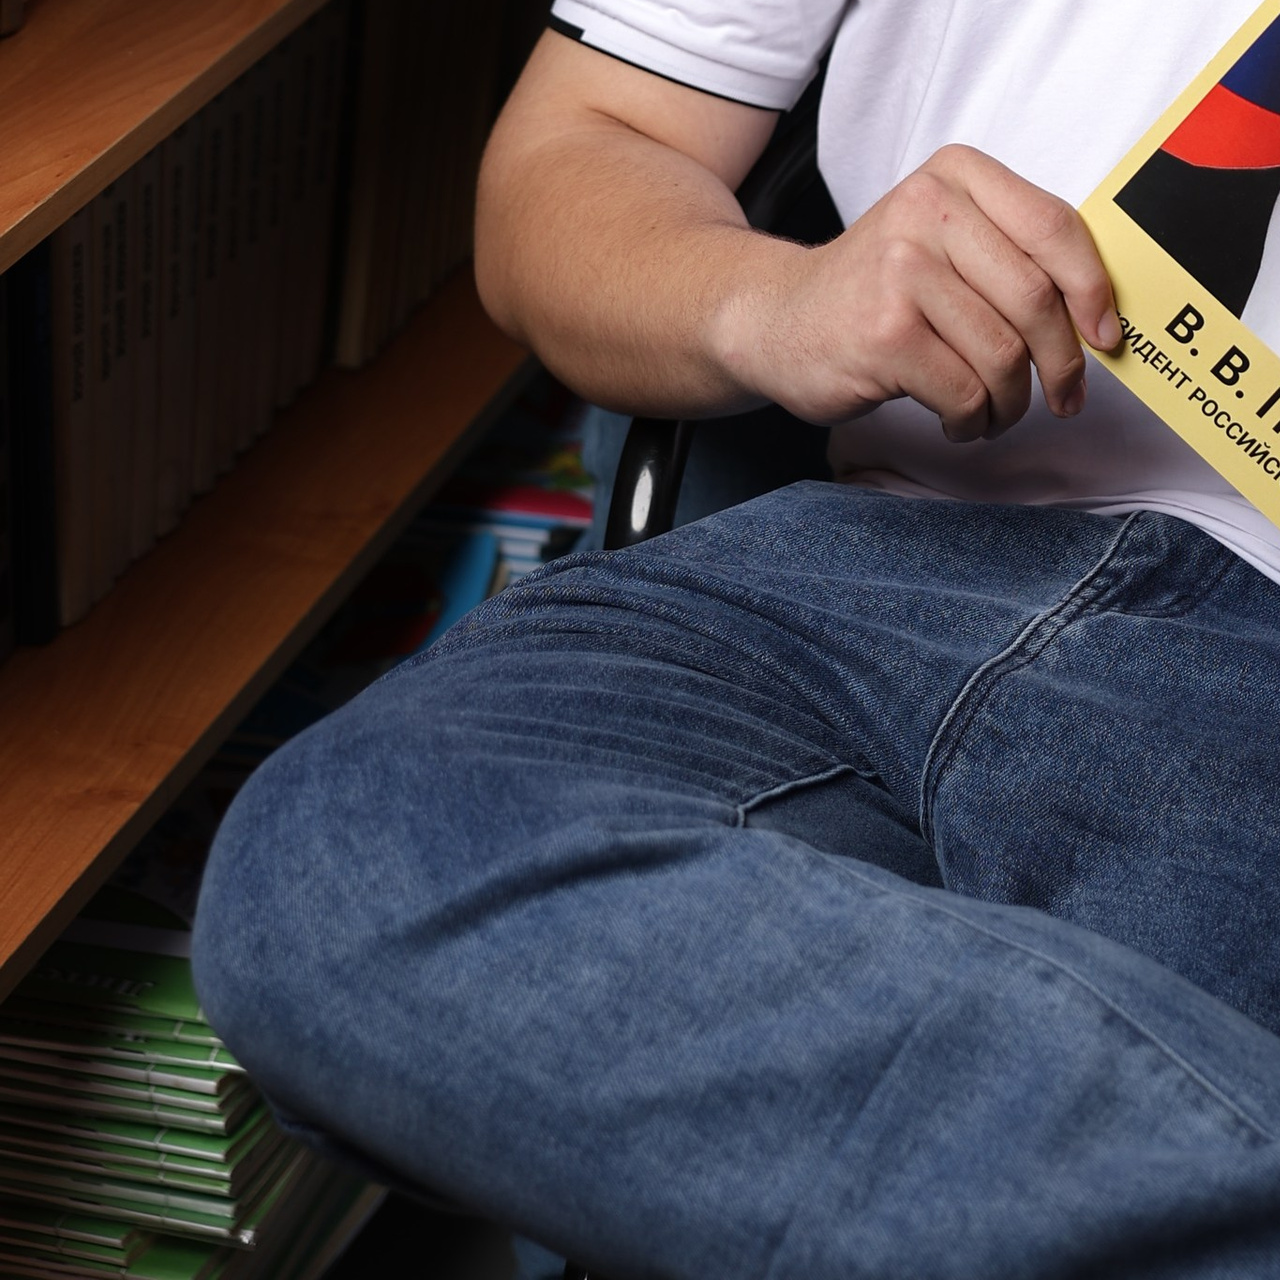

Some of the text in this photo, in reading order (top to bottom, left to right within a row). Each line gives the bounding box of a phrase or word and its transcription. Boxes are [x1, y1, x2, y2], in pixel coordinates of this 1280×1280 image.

[1117, 311, 1193, 390] ЗИДЕНТ
[1164, 302, 1205, 357] В.
[1209, 344, 1251, 399] В.
